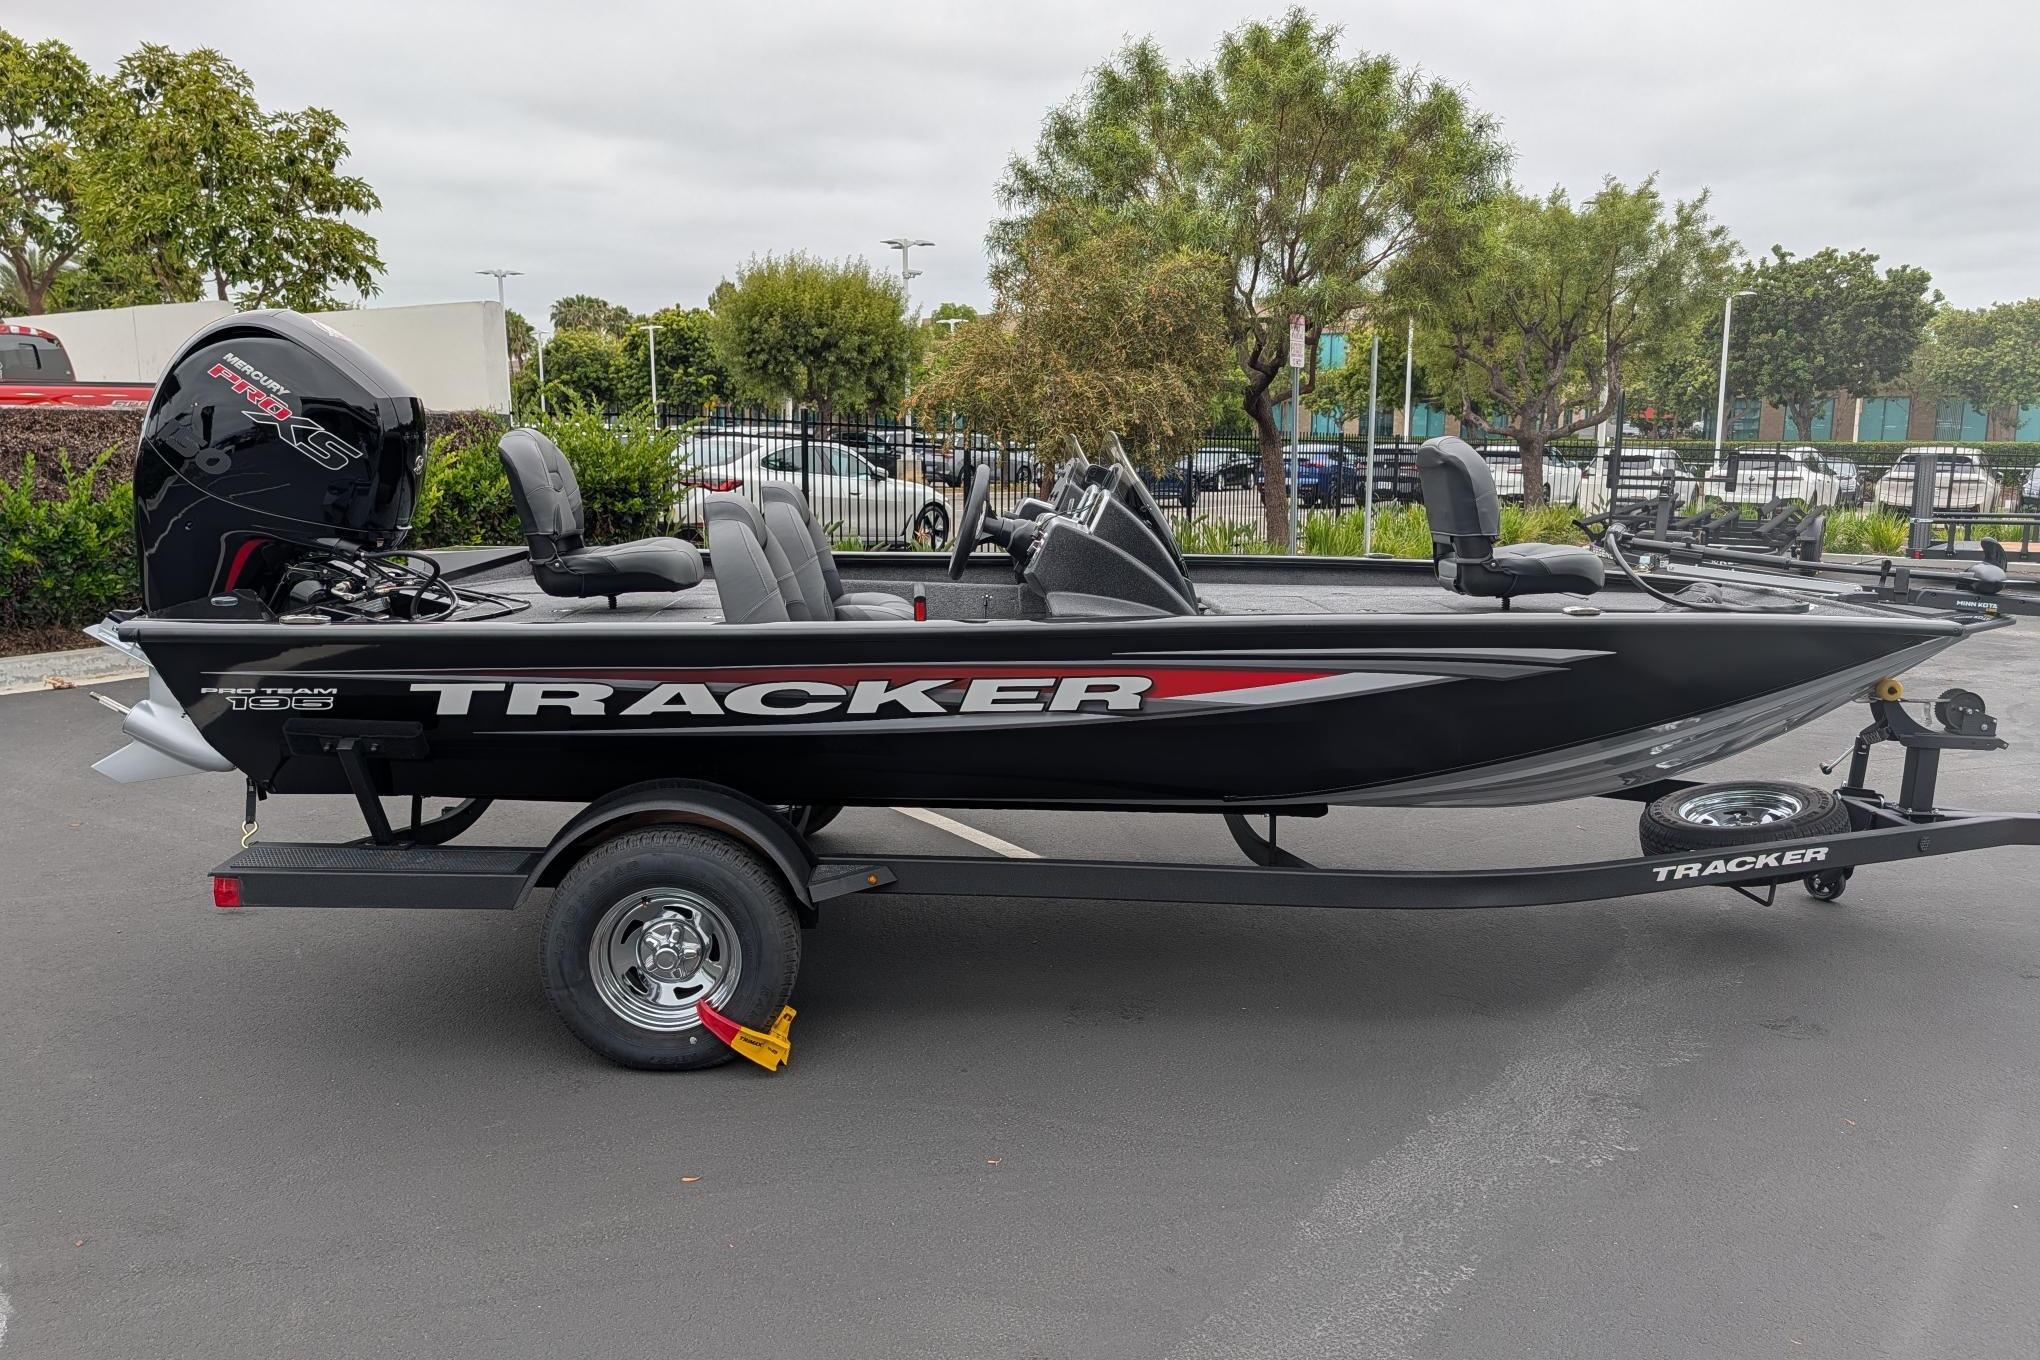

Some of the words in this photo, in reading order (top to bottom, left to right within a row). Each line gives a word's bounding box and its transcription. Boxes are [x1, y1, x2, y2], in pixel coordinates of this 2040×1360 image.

[207, 363, 293, 421] PRO
[222, 352, 291, 396] MERCURY
[241, 410, 363, 471] XS
[225, 696, 334, 711] 195
[409, 675, 1153, 716] TRACKER
[1652, 847, 1830, 883] TRACKER
